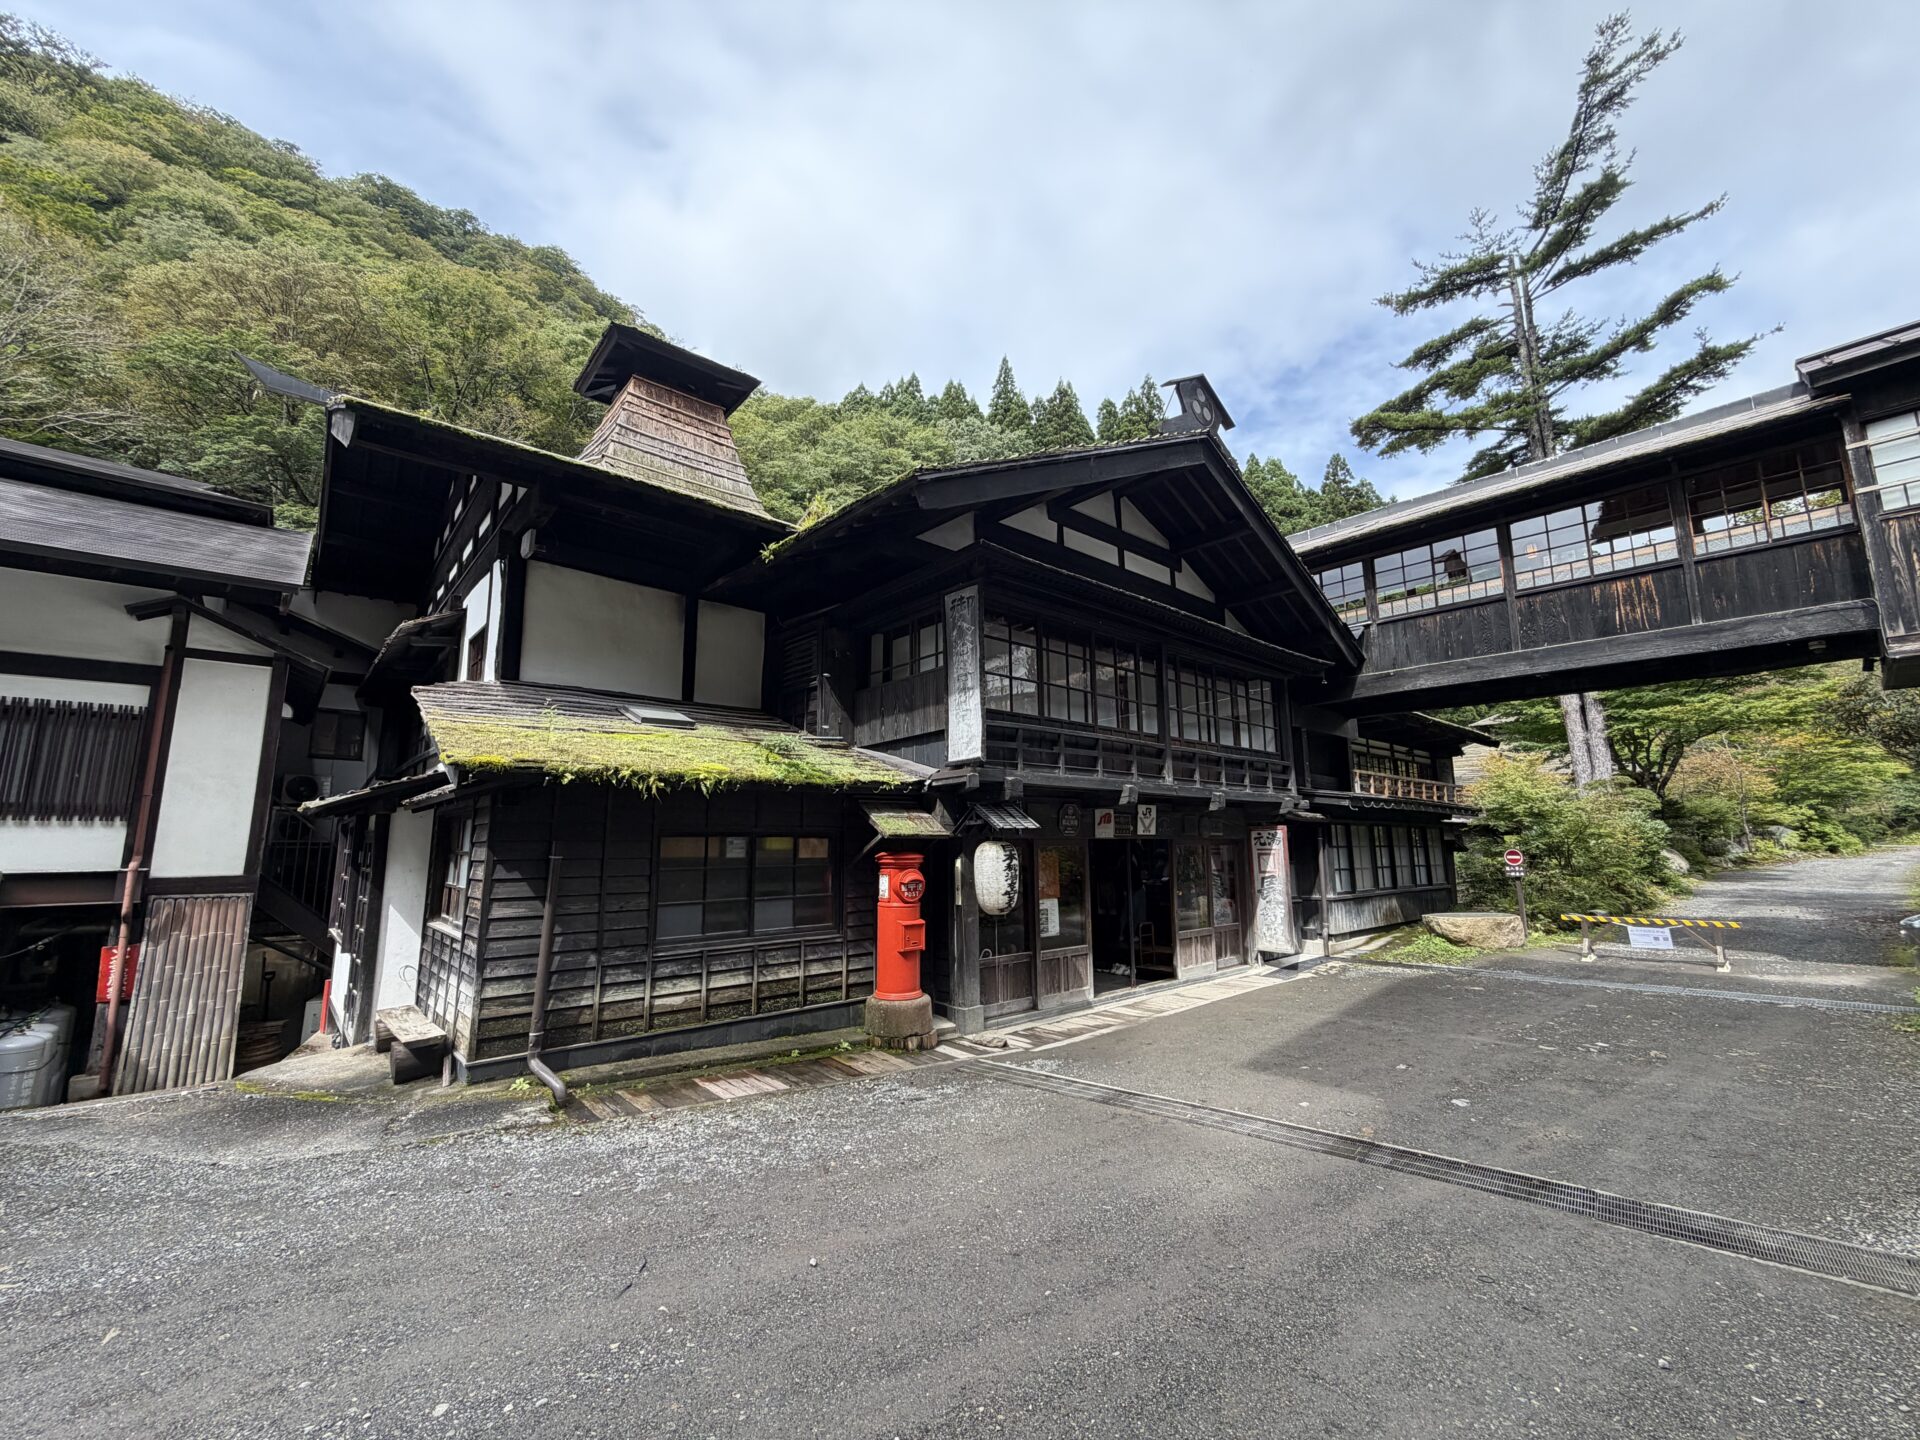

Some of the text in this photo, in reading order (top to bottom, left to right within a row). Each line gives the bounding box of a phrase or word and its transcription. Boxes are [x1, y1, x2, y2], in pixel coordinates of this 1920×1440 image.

[1097, 812, 1112, 826] JTB
[1142, 808, 1152, 816] JR
[1254, 831, 1281, 846] 元湯
